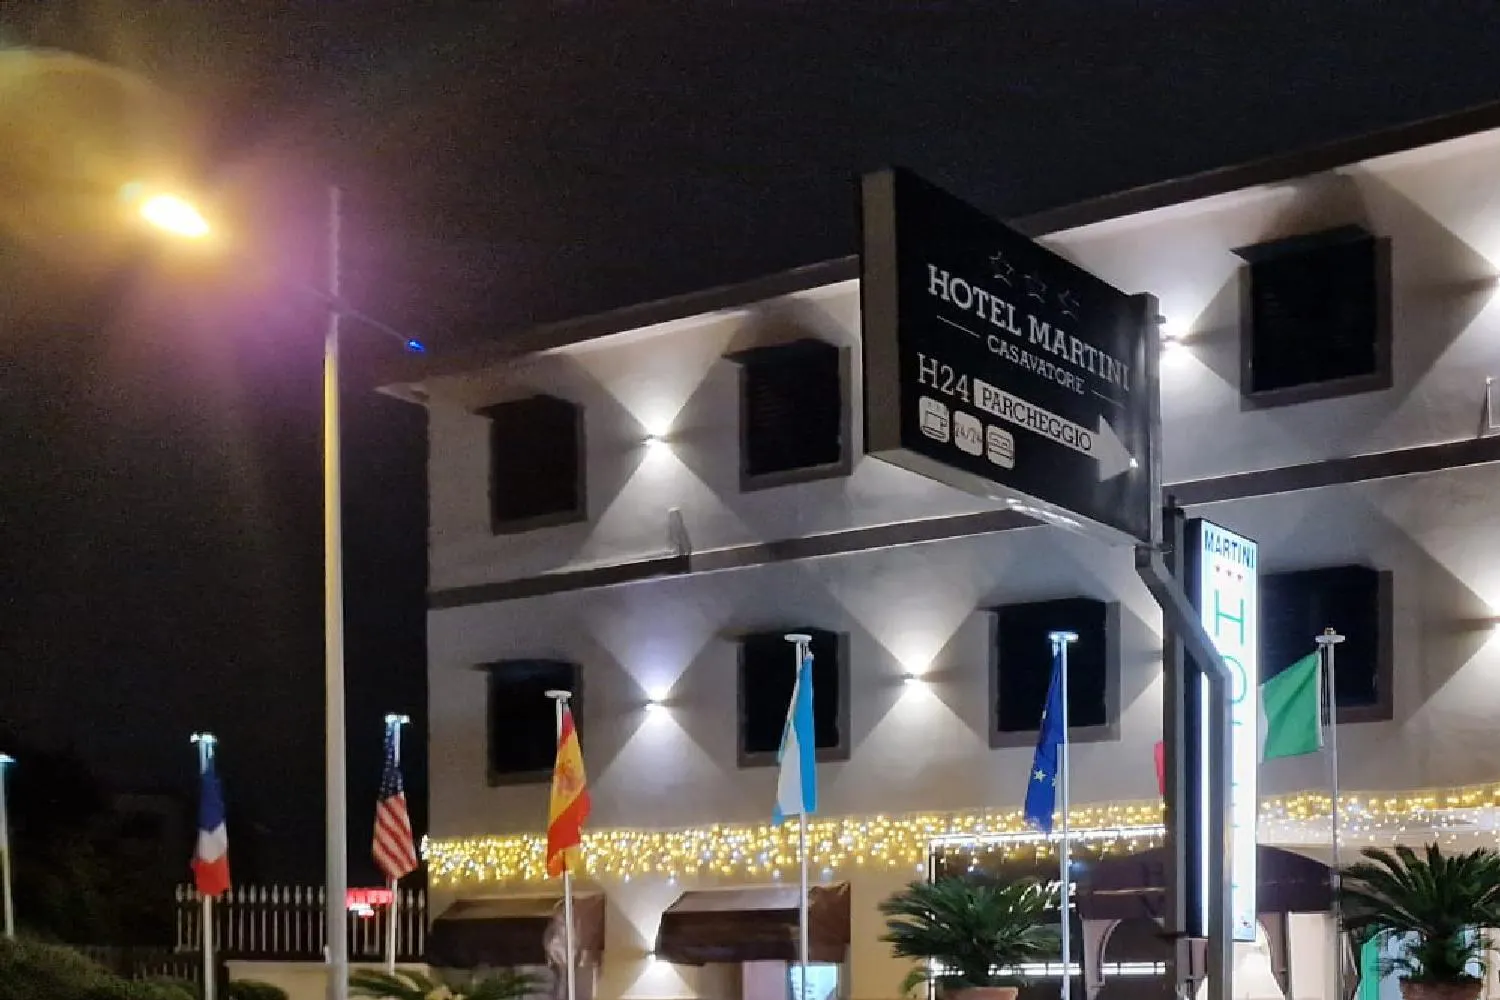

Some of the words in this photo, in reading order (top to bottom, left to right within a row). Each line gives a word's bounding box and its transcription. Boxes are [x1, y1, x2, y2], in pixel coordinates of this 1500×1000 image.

[927, 263, 1022, 336] HOTEL
[1028, 314, 1130, 391] MARTINI
[987, 334, 1085, 395] CASAVATORE
[917, 351, 970, 403] H24
[981, 386, 1093, 452] PARCHEGGIO
[1204, 529, 1255, 569] MARTINI
